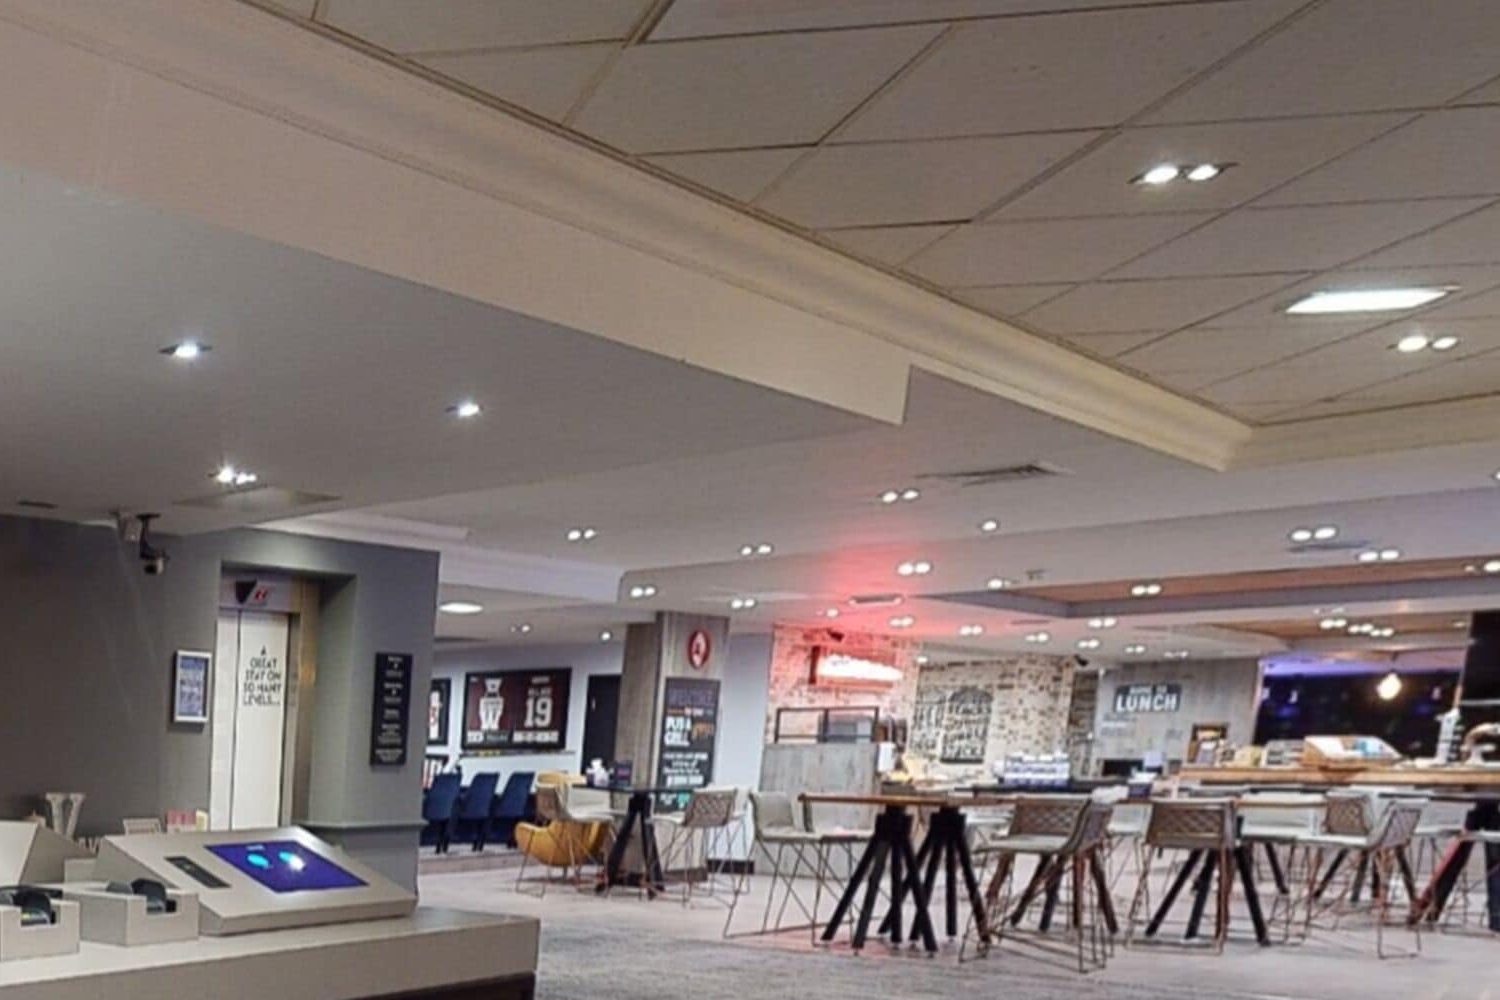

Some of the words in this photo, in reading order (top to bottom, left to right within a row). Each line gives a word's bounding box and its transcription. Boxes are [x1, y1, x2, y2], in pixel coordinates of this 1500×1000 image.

[250, 657, 277, 668] GREAT
[1116, 693, 1178, 711] LUNCH
[524, 697, 552, 727] 19
